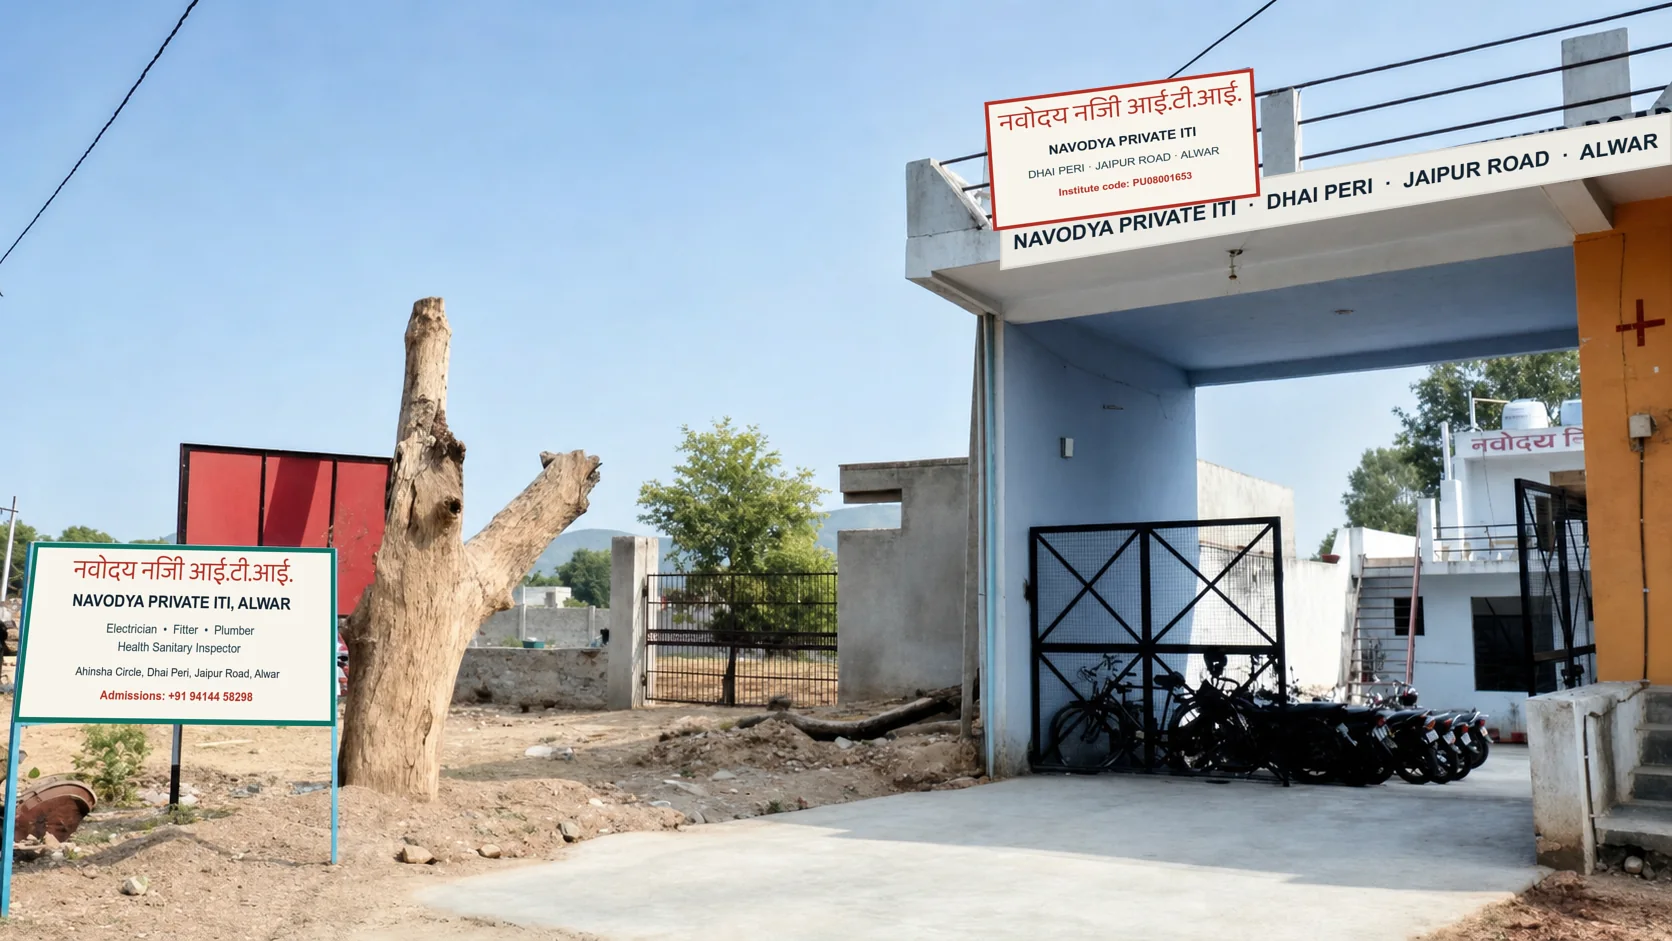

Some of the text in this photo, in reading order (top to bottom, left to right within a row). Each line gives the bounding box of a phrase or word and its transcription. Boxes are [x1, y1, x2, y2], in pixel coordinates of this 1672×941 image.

[998, 106, 1069, 130] नवोदय
[1128, 80, 1241, 115] आई.टी.आई.
[1049, 127, 1196, 155] NAVODYA PRIVATE ITI
[1029, 147, 1219, 178] DHAI PERI JAIPUR ROAD ALWAR
[1015, 134, 1658, 249] NAVODYA PRIVATE ITI DHAI PERI JAIPUR ROAD ALWAR
[1059, 172, 1192, 196] Institute code: PU08001653
[1471, 431, 1556, 452] नवोदय
[74, 555, 138, 581] नवोदय
[189, 557, 293, 586] आई.टी.आई.
[73, 594, 290, 611] NAVODYA PRIVATE ITI, ALWAR
[107, 623, 254, 635] Electrician Fitter Plumber
[118, 642, 241, 655] Health Sanitary Inspector
[75, 667, 280, 679] Ahinsha Circle, Dhai Peri, Jaipur Road, Alwar
[100, 690, 252, 701] Admissions: +91 94144 58298
